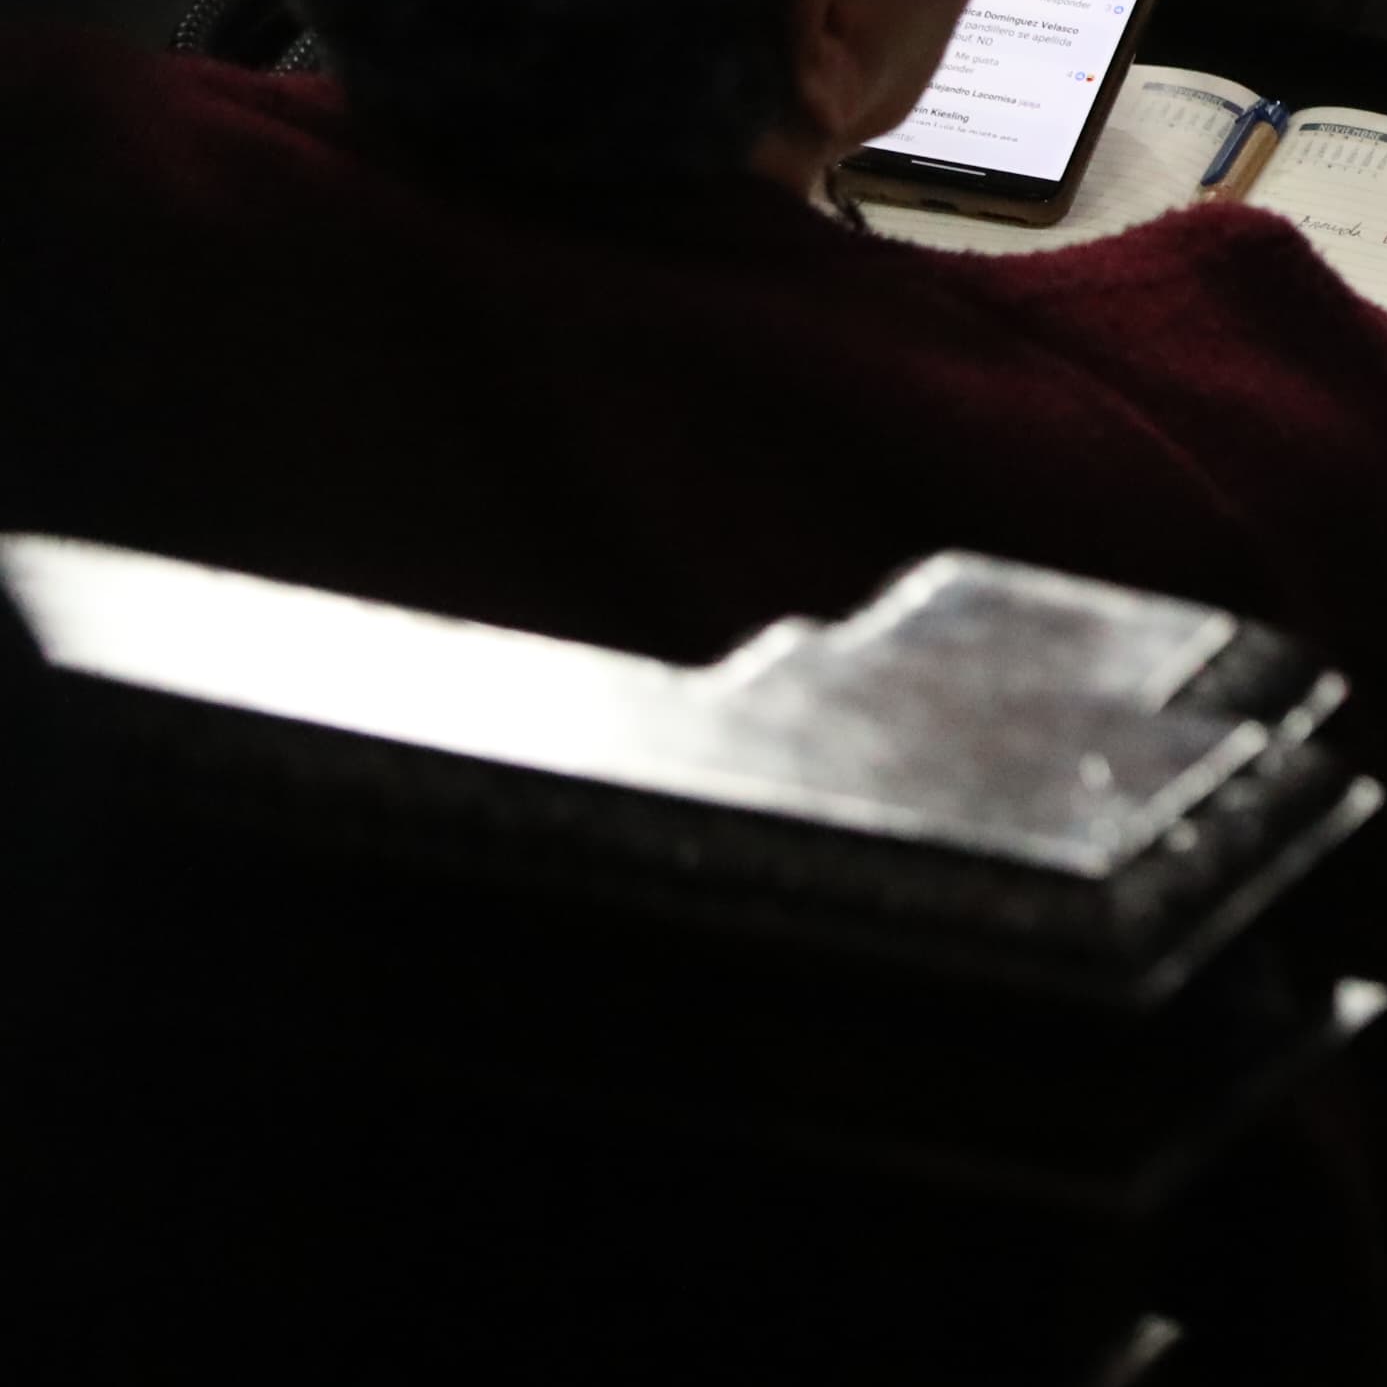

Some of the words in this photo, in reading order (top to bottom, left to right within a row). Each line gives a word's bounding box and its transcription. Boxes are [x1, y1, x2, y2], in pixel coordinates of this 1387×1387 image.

[964, 20, 1015, 38] pandillero
[1017, 30, 1030, 40] se
[1031, 32, 1073, 49] apellida
[1041, 21, 1079, 35] Velasco
[931, 108, 970, 124] Kiesling
